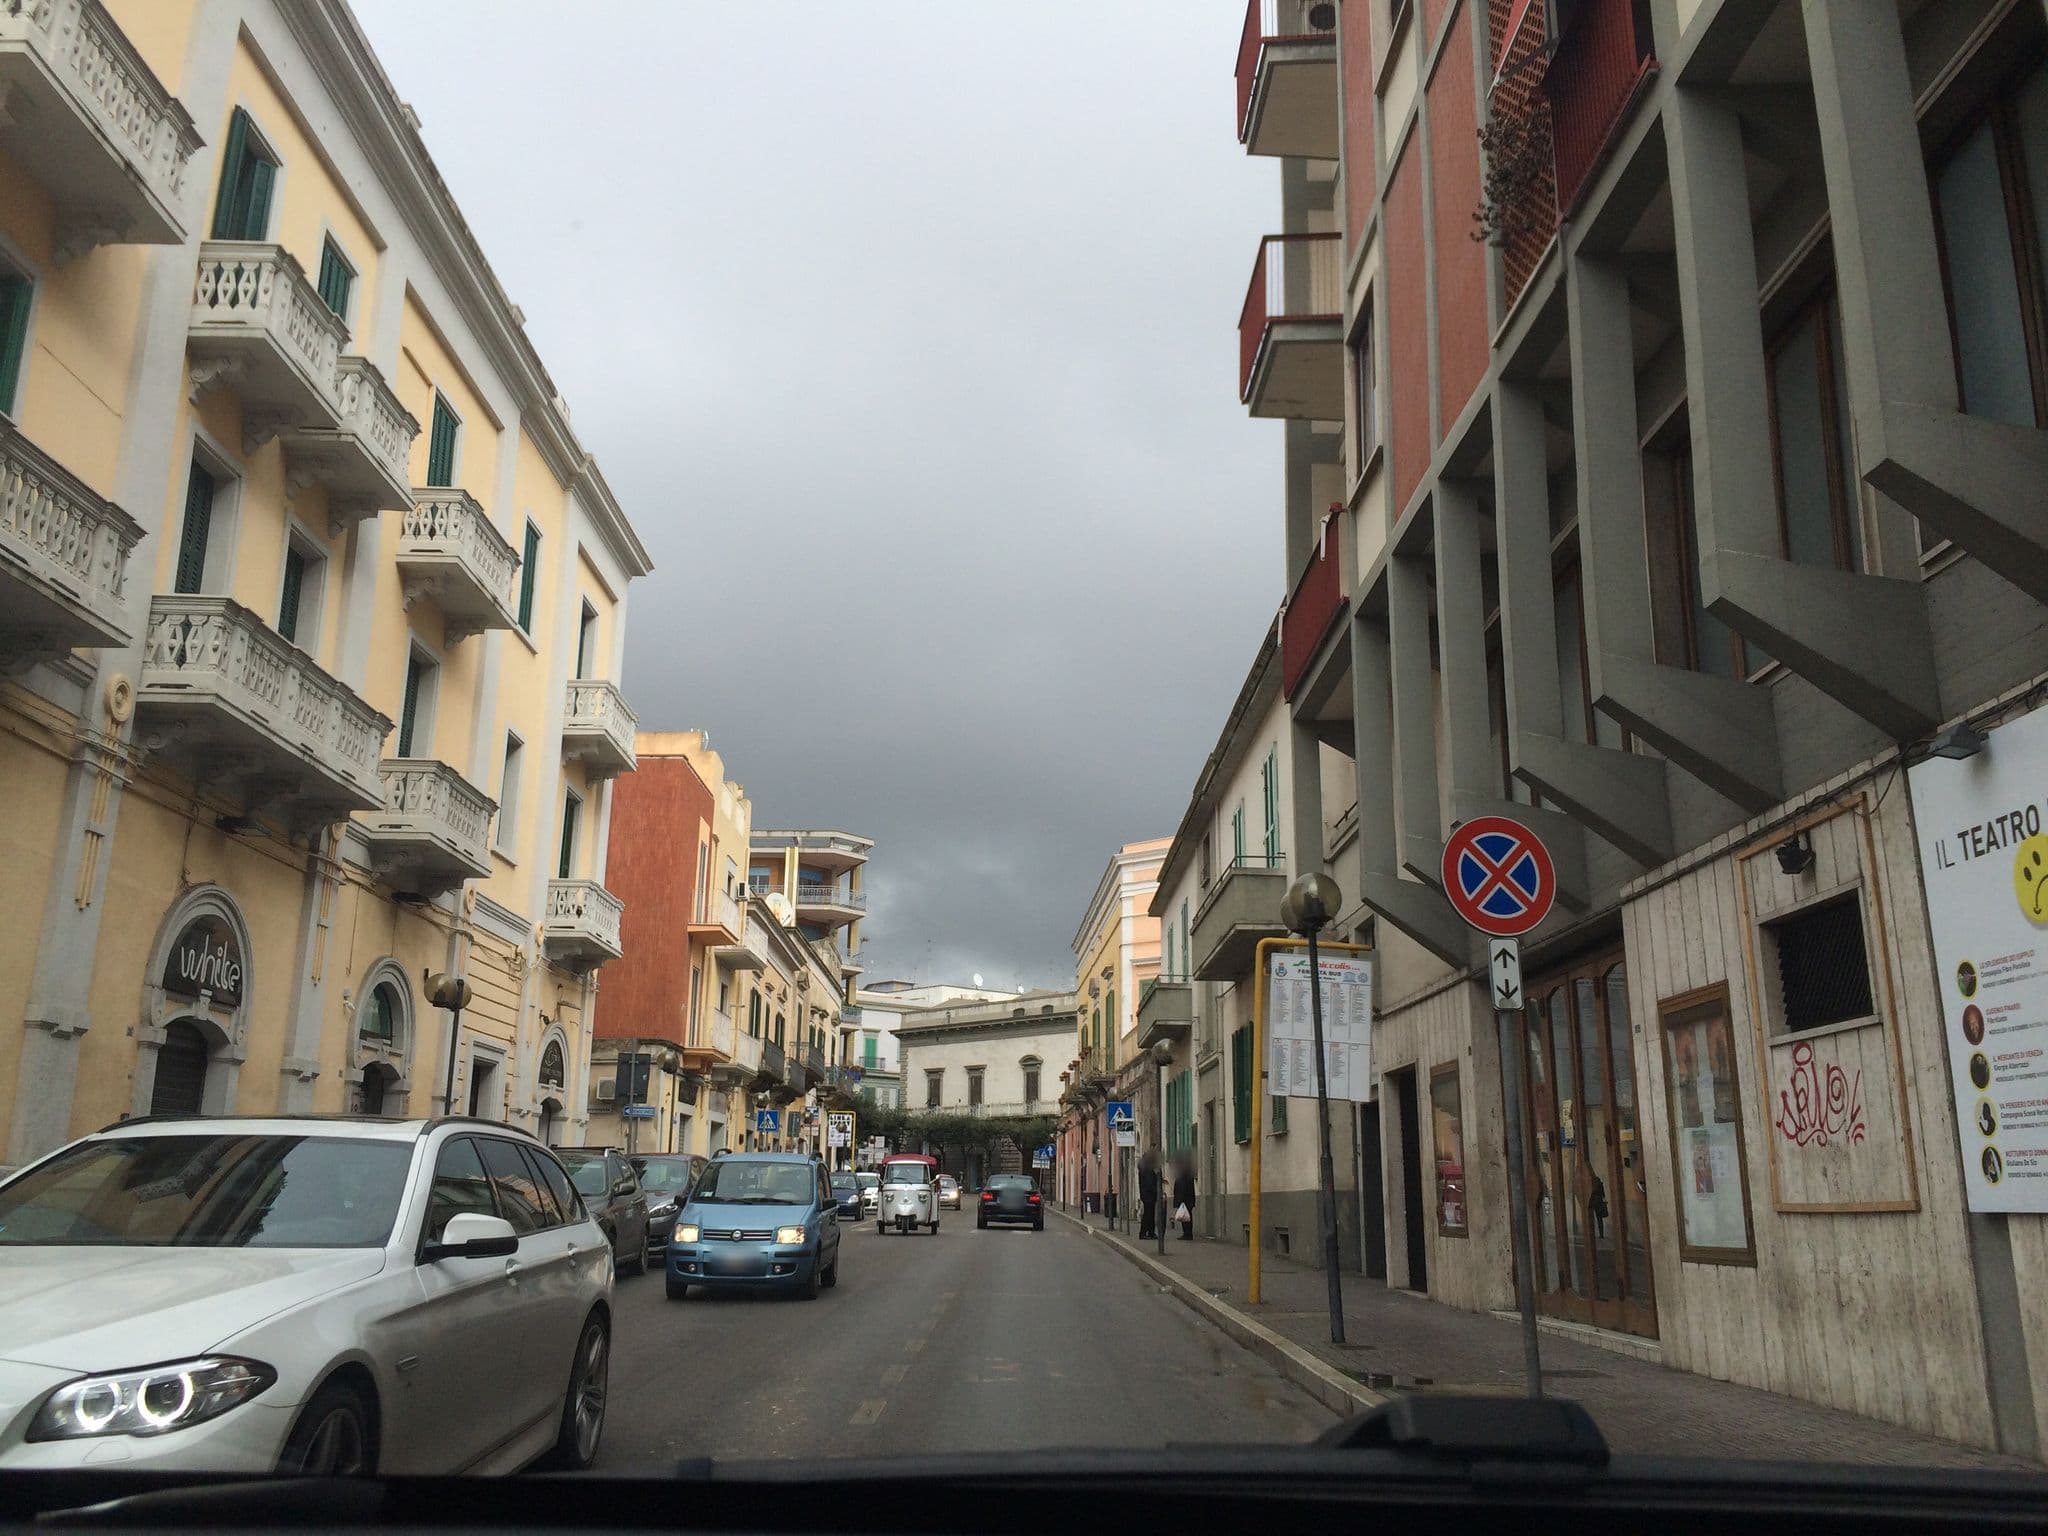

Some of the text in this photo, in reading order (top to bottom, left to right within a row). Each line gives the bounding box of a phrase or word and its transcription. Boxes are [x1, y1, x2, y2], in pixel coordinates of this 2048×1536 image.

[1935, 804, 2040, 870] IL TEATRO
[181, 934, 240, 991] white
